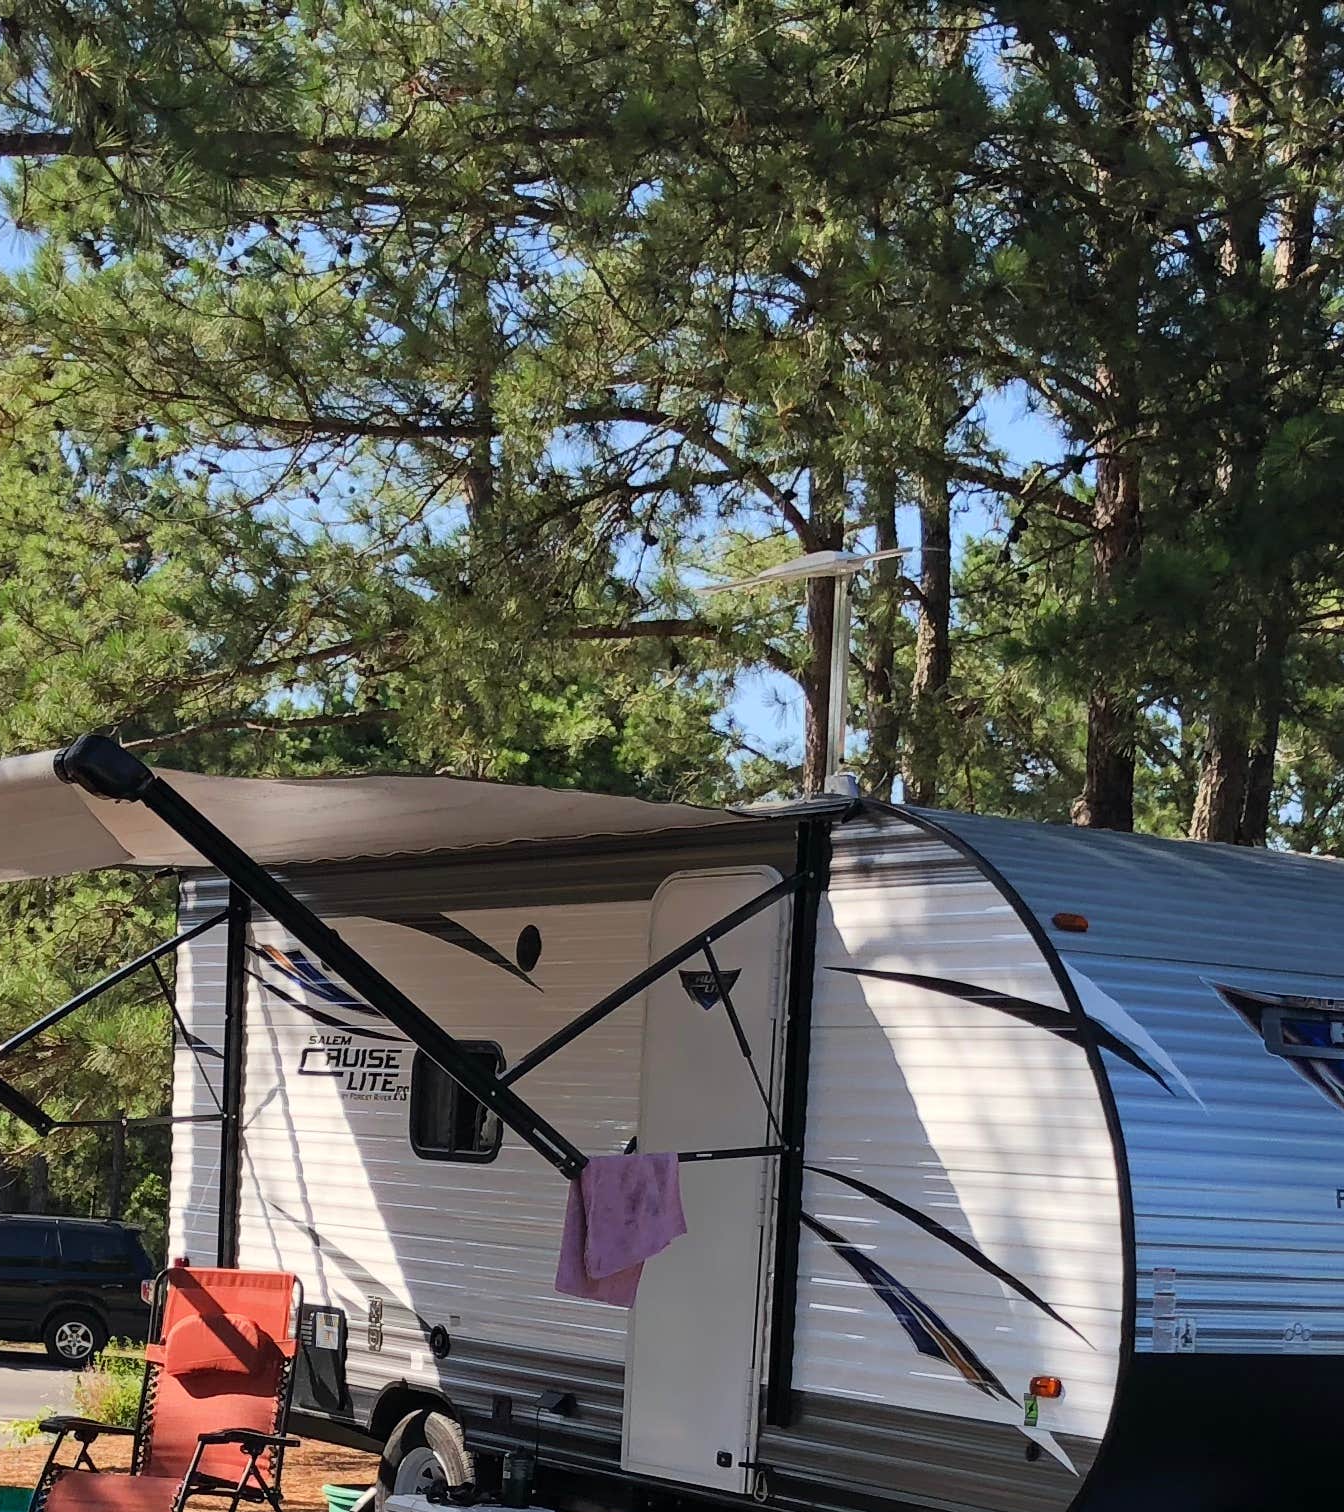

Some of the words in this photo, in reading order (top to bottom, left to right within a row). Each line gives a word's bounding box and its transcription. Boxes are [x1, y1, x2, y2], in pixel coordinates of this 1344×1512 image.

[309, 1036, 352, 1045] SALEM
[298, 1048, 402, 1077] CRUISE
[346, 1072, 399, 1092] LITE
